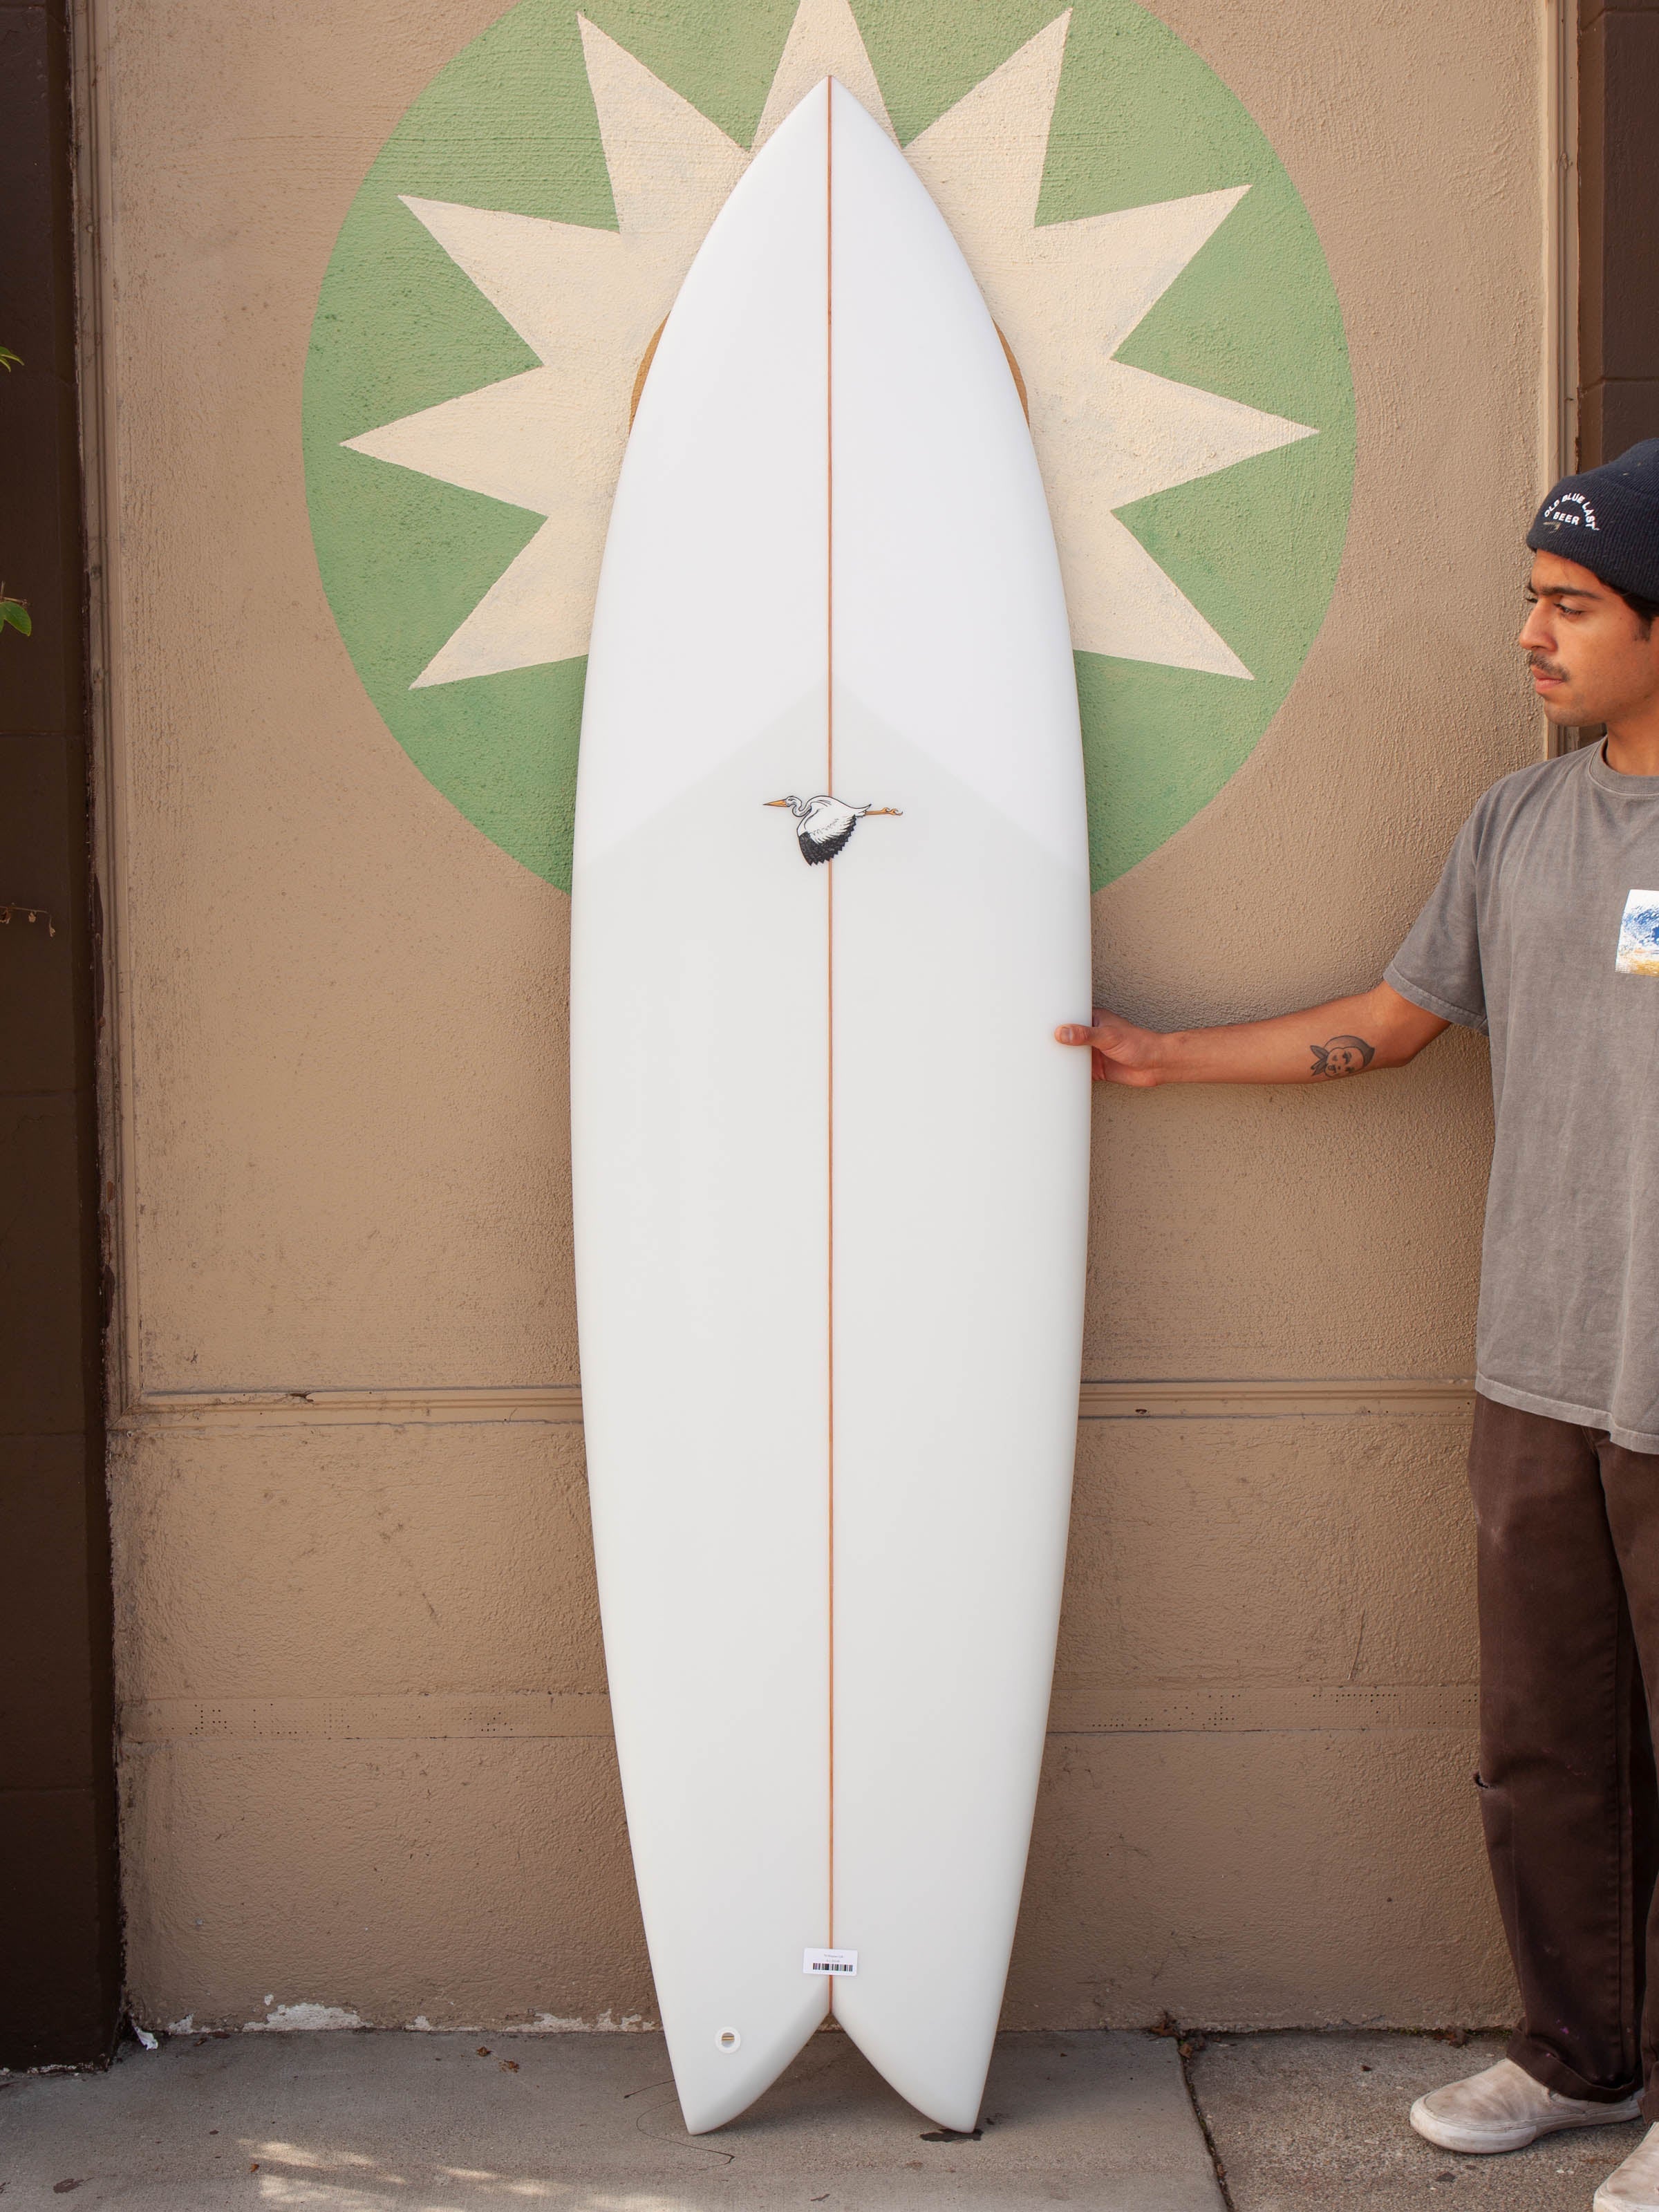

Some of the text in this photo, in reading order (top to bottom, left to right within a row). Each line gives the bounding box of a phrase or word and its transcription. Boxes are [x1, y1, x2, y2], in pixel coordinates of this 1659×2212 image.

[1544, 493, 1600, 531] OLD BLUE LAST
[1553, 512, 1580, 525] BEER
